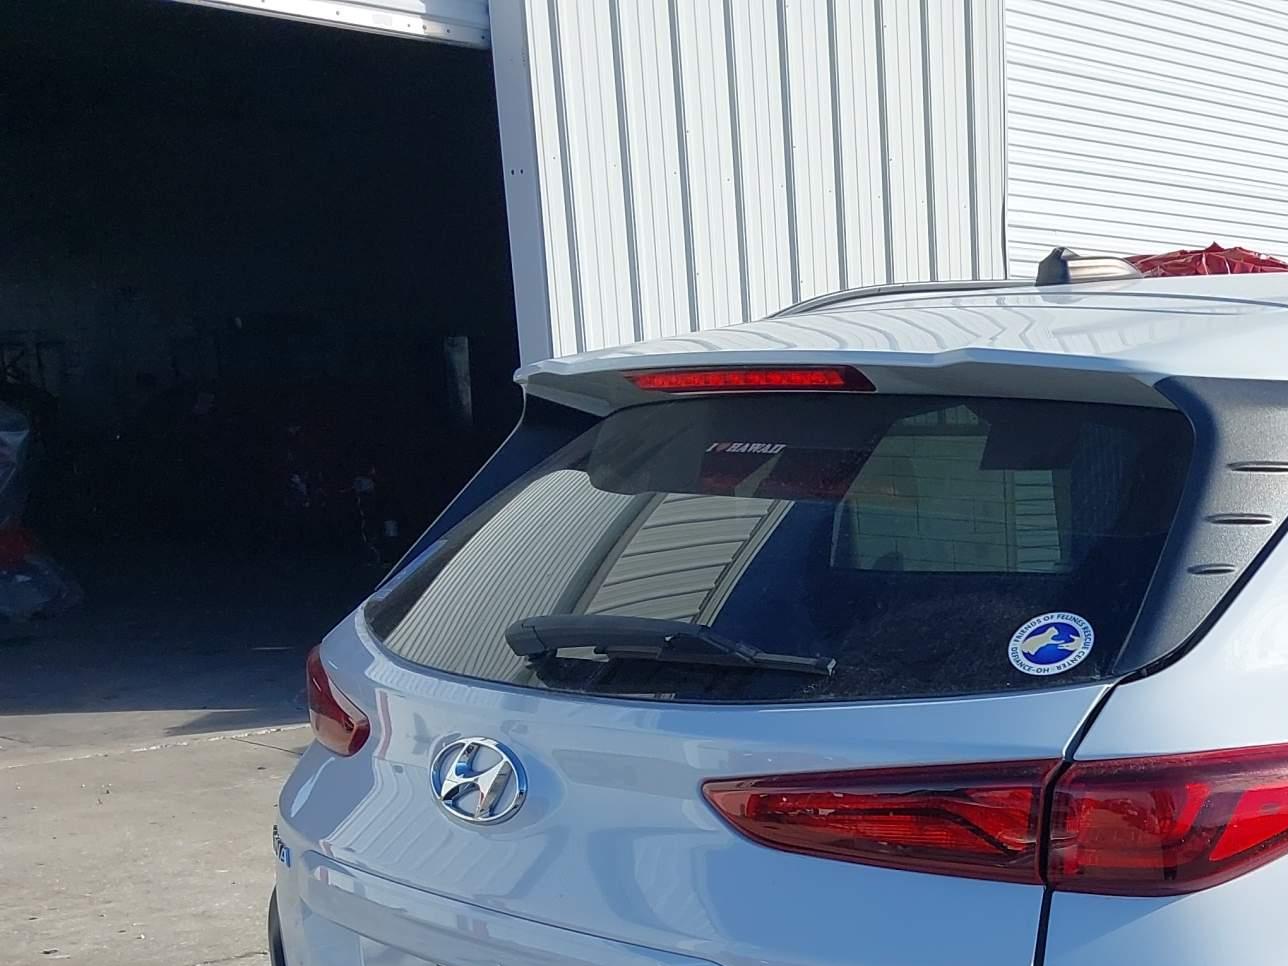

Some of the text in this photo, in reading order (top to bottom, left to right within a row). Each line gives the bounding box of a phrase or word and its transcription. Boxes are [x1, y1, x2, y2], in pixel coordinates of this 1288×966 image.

[1043, 614, 1055, 622] OF
[1014, 618, 1042, 643] FRIENDS
[1081, 625, 1093, 651] RESCUE
[1055, 650, 1086, 672] CENTER
